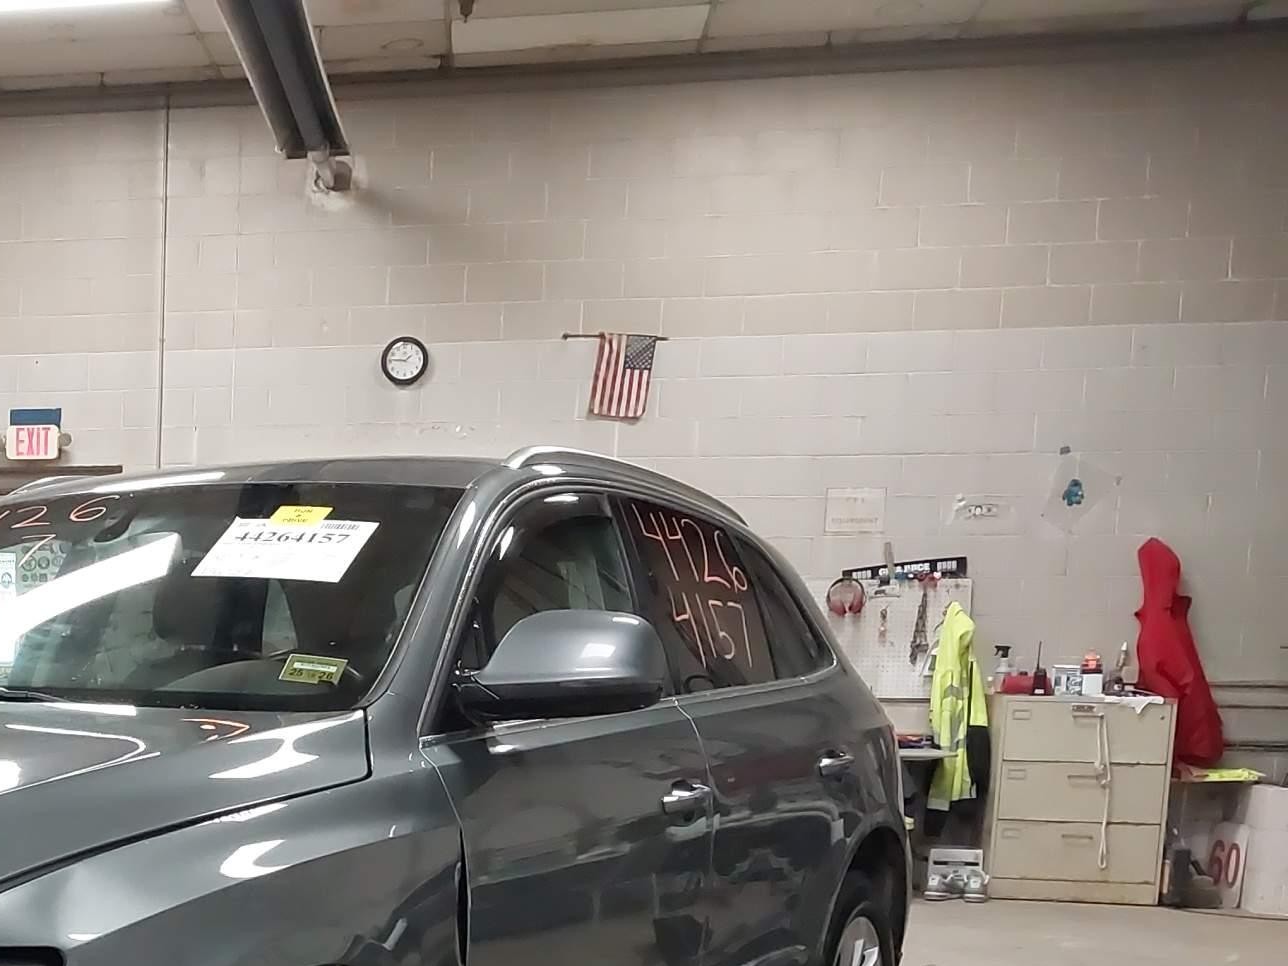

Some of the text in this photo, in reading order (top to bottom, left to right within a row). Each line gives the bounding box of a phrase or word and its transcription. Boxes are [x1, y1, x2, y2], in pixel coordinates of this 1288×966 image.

[16, 427, 51, 456] EXIT
[235, 531, 350, 544] 44264157
[632, 503, 748, 593] 4426
[667, 586, 752, 668] 4157
